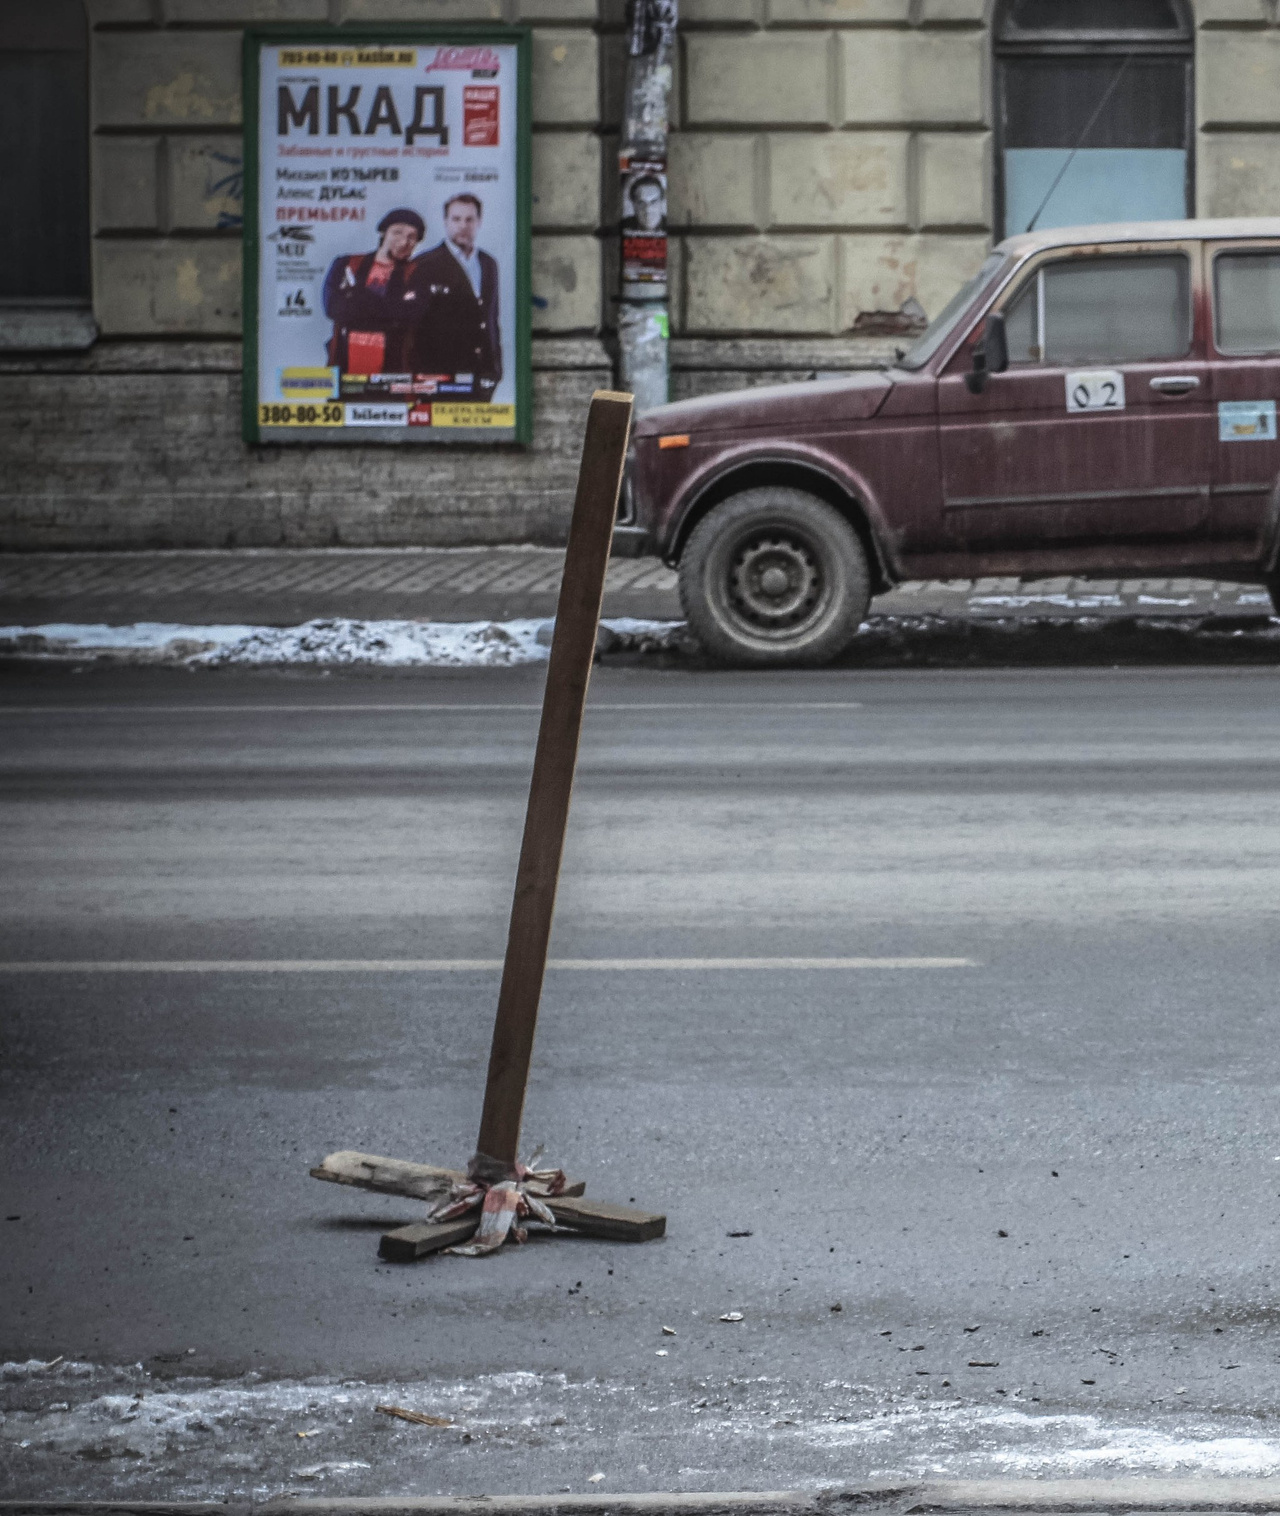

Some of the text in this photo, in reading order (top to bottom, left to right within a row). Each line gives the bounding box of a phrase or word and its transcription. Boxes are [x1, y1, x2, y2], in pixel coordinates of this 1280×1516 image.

[277, 84, 449, 146] МКАД
[276, 167, 399, 182] Михаил КОЗЫРЕВ
[276, 186, 367, 202] Алекс ДУБАС
[275, 206, 366, 222] ПРЕМЬЕРА!
[262, 405, 342, 423] 380-80-50
[352, 408, 404, 422] bileter
